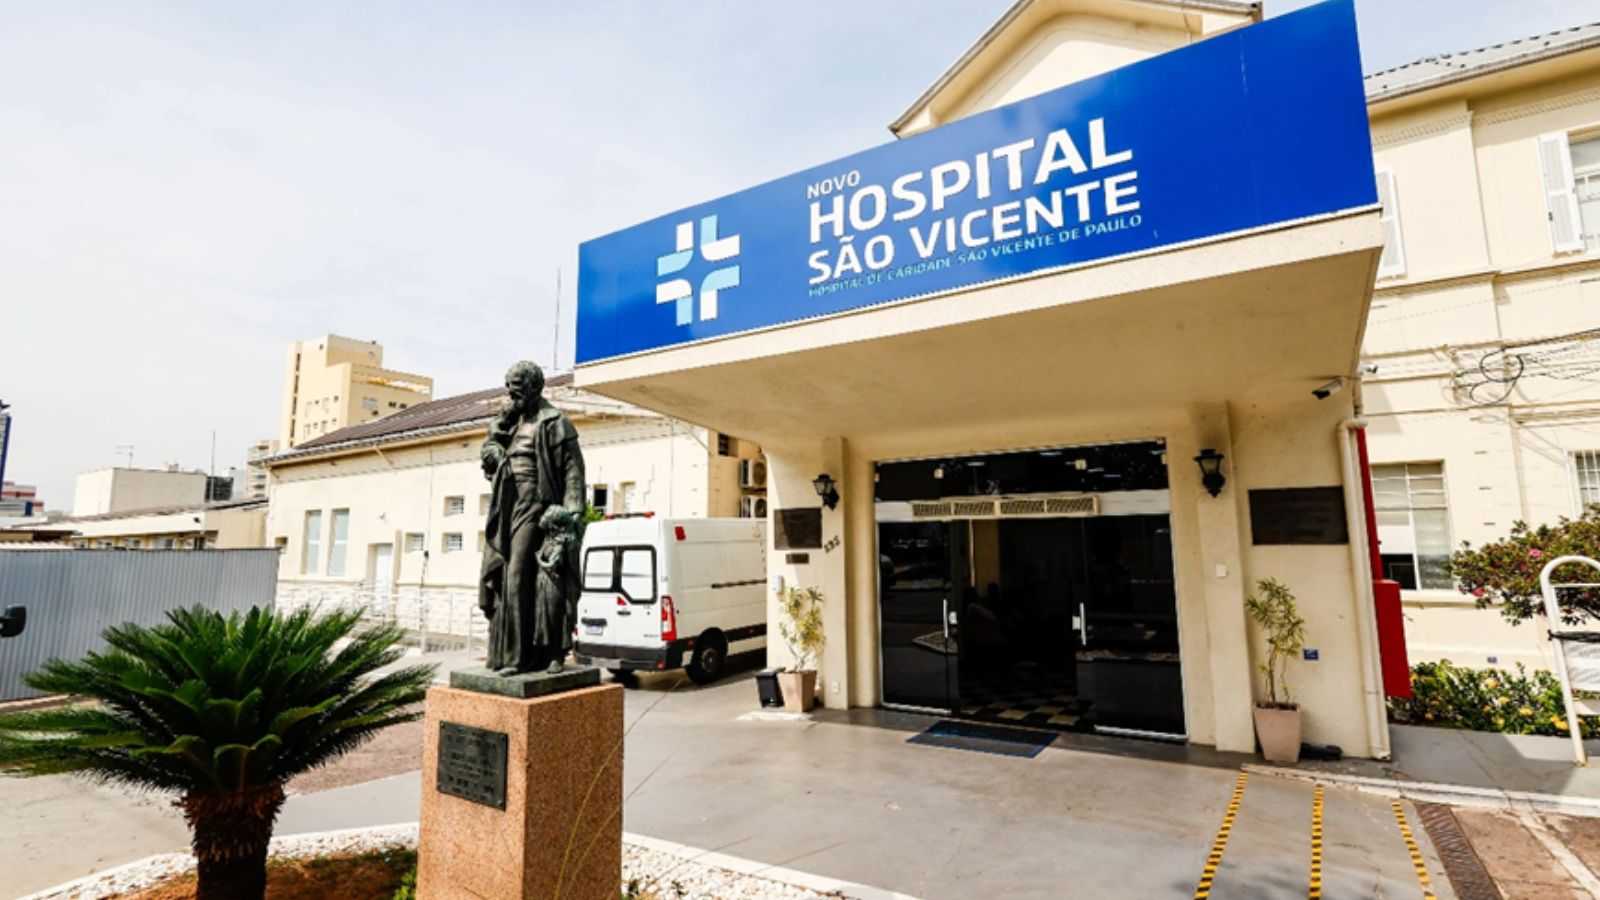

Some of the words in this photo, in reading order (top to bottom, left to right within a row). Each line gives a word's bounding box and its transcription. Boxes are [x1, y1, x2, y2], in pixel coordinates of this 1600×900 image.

[806, 169, 861, 199] NOVO
[808, 235, 895, 285] SÃO
[909, 171, 1141, 258] VICENTE
[809, 117, 1133, 243] HOSPITAL
[808, 278, 863, 297] HOSPITAL
[991, 233, 1055, 257] VICENTE
[1059, 228, 1081, 243] DE
[1084, 214, 1142, 237] PAULO
